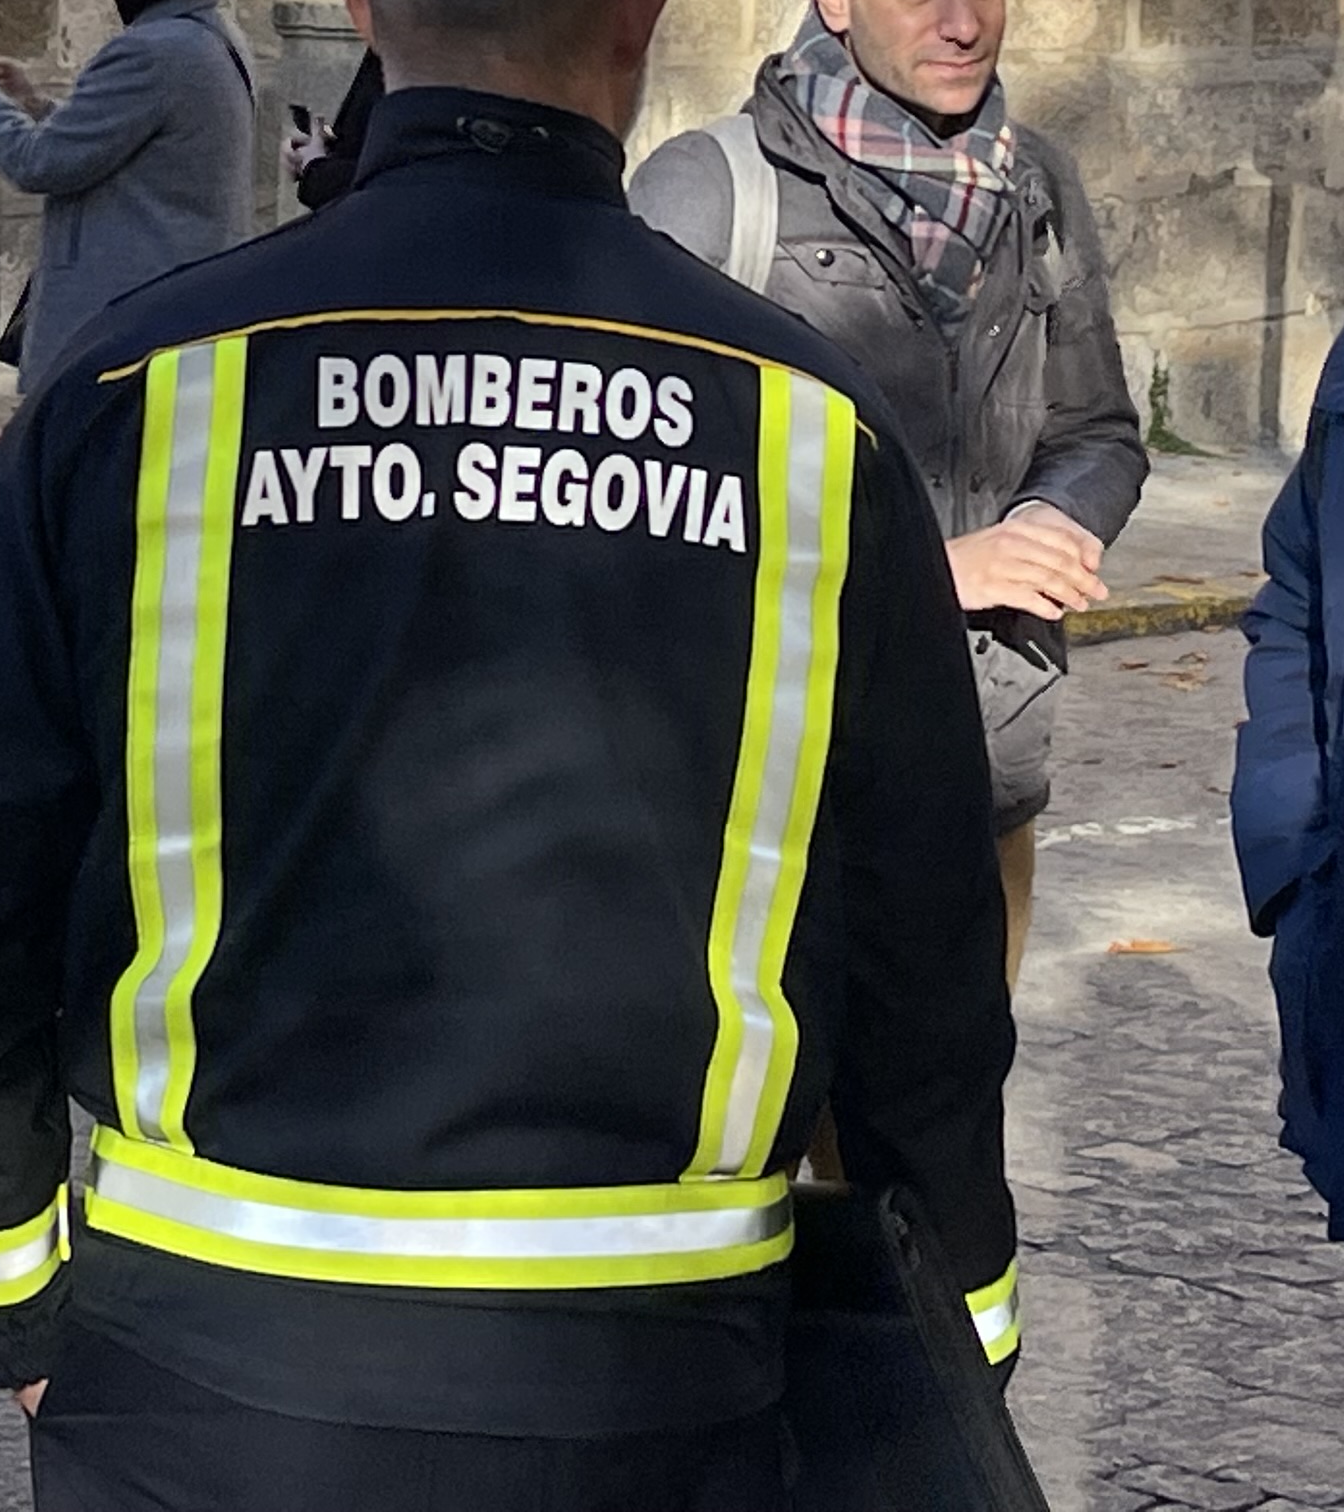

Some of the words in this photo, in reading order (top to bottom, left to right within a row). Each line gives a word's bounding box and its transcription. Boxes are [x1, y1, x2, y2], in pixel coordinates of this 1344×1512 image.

[317, 354, 694, 447] BOMBEROS
[241, 443, 436, 526] AYTO.
[453, 444, 746, 552] SEGOVIA
